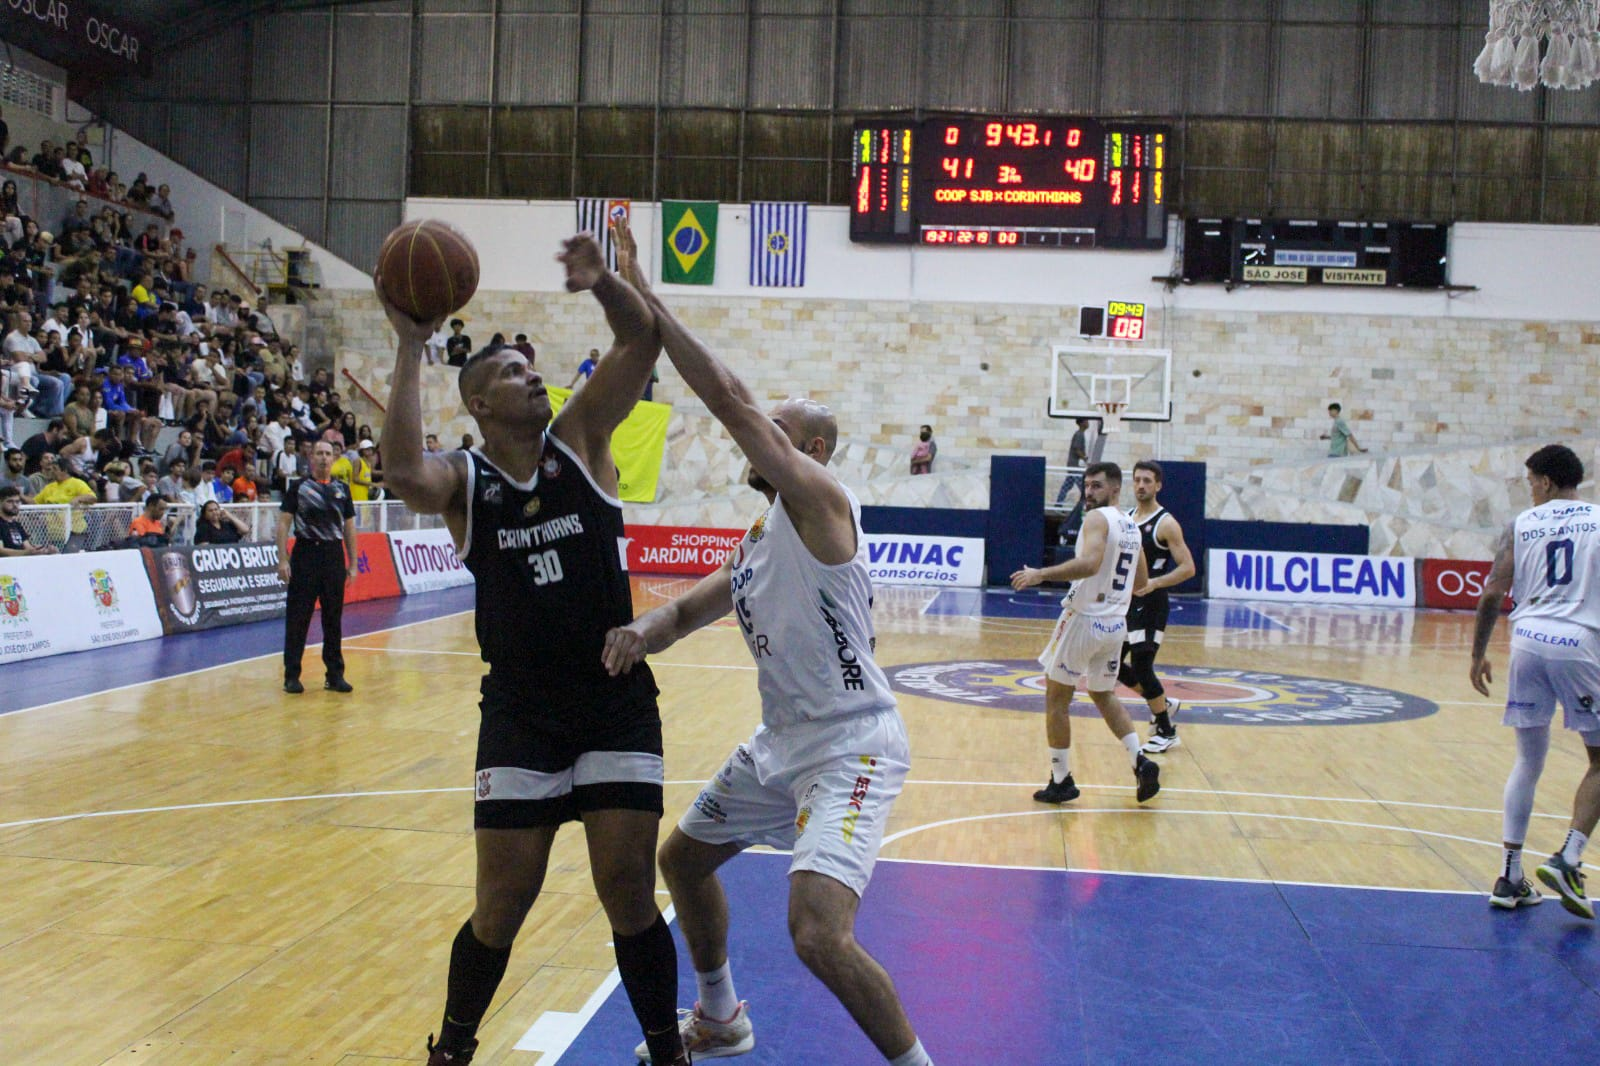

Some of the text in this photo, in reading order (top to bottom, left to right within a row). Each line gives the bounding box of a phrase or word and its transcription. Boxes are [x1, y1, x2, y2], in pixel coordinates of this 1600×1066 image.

[86, 17, 138, 64] OSCAR
[943, 158, 974, 179] 41
[1065, 158, 1096, 182] 40
[935, 189, 967, 203] COOP
[970, 190, 993, 203] SJB
[1004, 191, 1082, 205] CORINTHIANS
[1325, 271, 1384, 283] VISITANTE
[1109, 302, 1144, 317] 09:43
[1114, 317, 1143, 338] 08
[497, 513, 584, 550] CRINTHIANS
[671, 534, 741, 549] SHOPPING
[1522, 522, 1597, 541] DOS SANTOS
[192, 548, 240, 573] GRUPO
[394, 538, 465, 576] Tomova
[640, 547, 734, 566] JARDIM ORI
[868, 542, 964, 568] VINAC
[1545, 538, 1574, 588] 0
[528, 548, 564, 587] 30
[868, 567, 958, 582] consórcios
[1112, 552, 1133, 591] 5
[1225, 551, 1405, 599] MILCLEAN
[198, 575, 248, 594] SEGURANÇA
[248, 574, 256, 588] E
[1516, 627, 1579, 647] MILCLEAN
